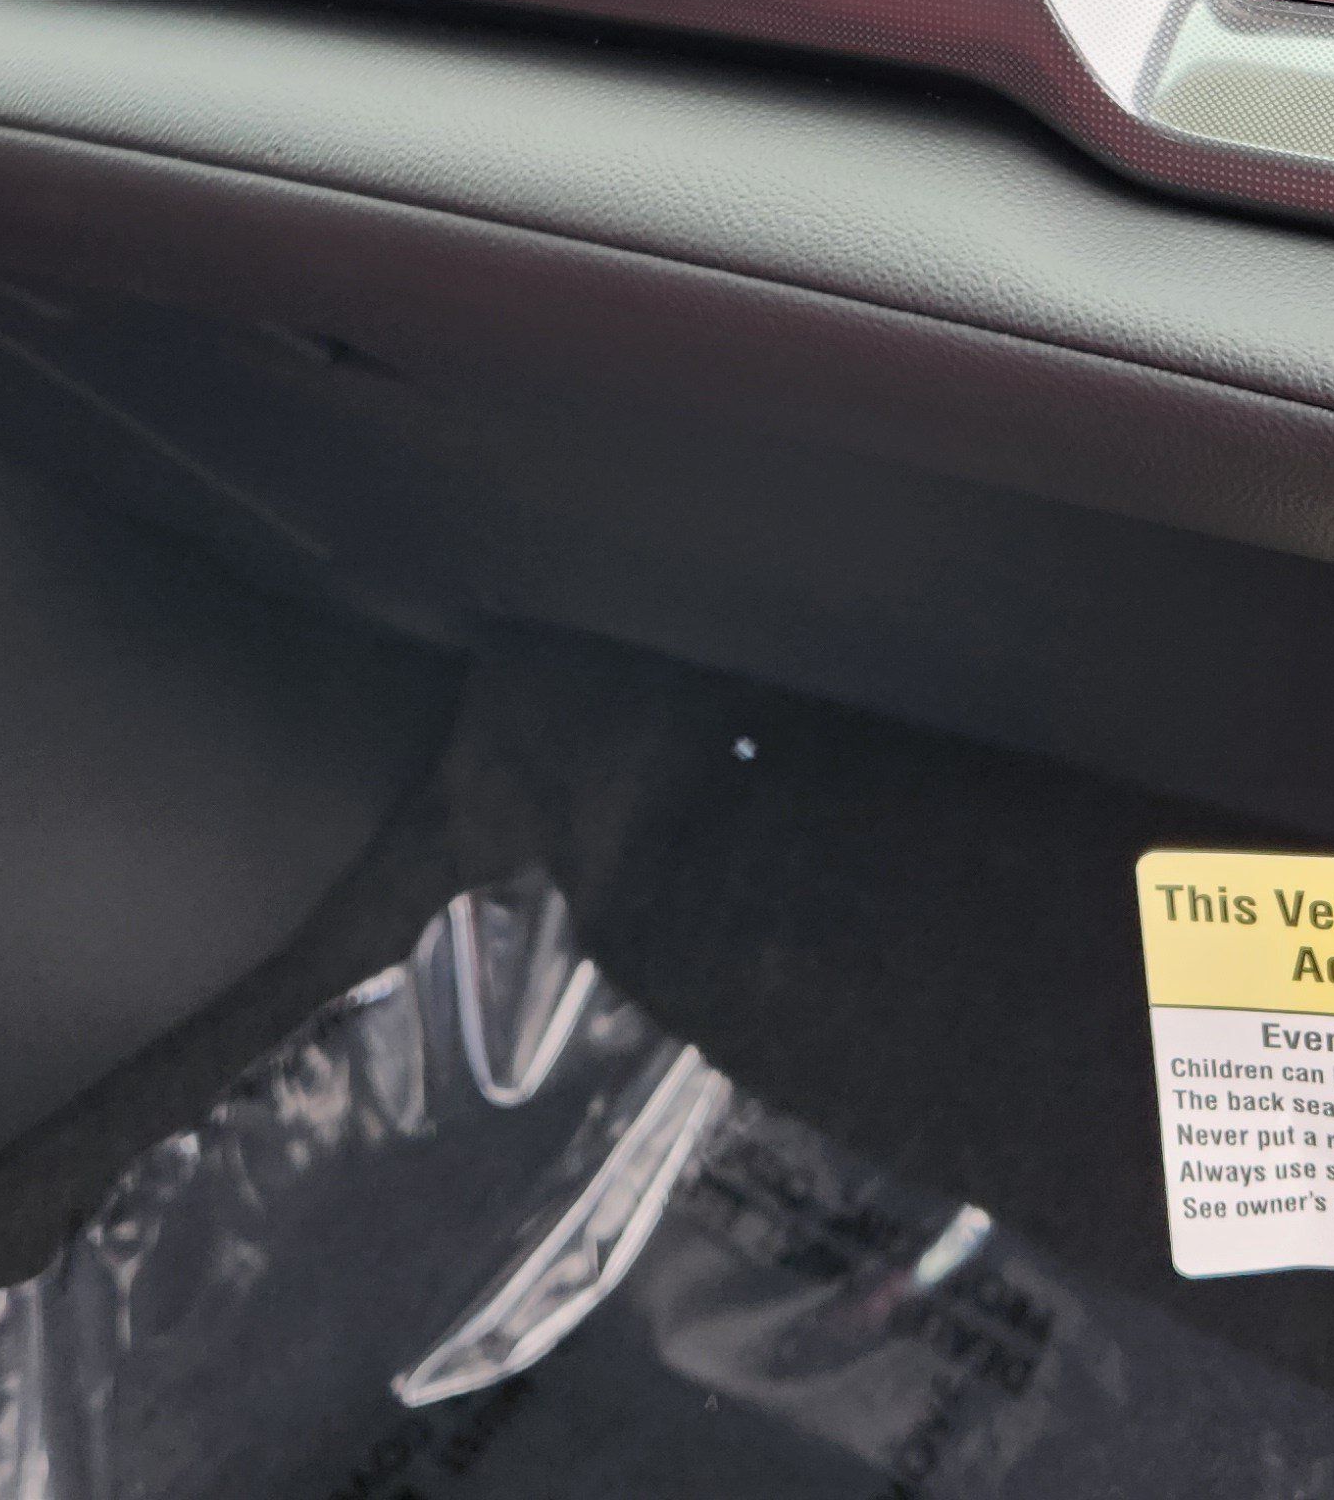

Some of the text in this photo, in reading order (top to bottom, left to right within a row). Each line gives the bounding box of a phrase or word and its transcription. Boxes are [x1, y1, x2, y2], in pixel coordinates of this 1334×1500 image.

[1155, 885, 1257, 925] This
[1171, 1058, 1273, 1080] Children
[1282, 1066, 1324, 1084] can
[1172, 1089, 1217, 1111] The
[1227, 1090, 1285, 1112] back
[1177, 1124, 1249, 1146] Never
[1257, 1126, 1295, 1151] put
[1304, 1131, 1317, 1147] a
[1180, 1160, 1266, 1187] Always
[1275, 1162, 1316, 1180] use
[1183, 1197, 1226, 1219] See
[1236, 1191, 1327, 1217] owner's
